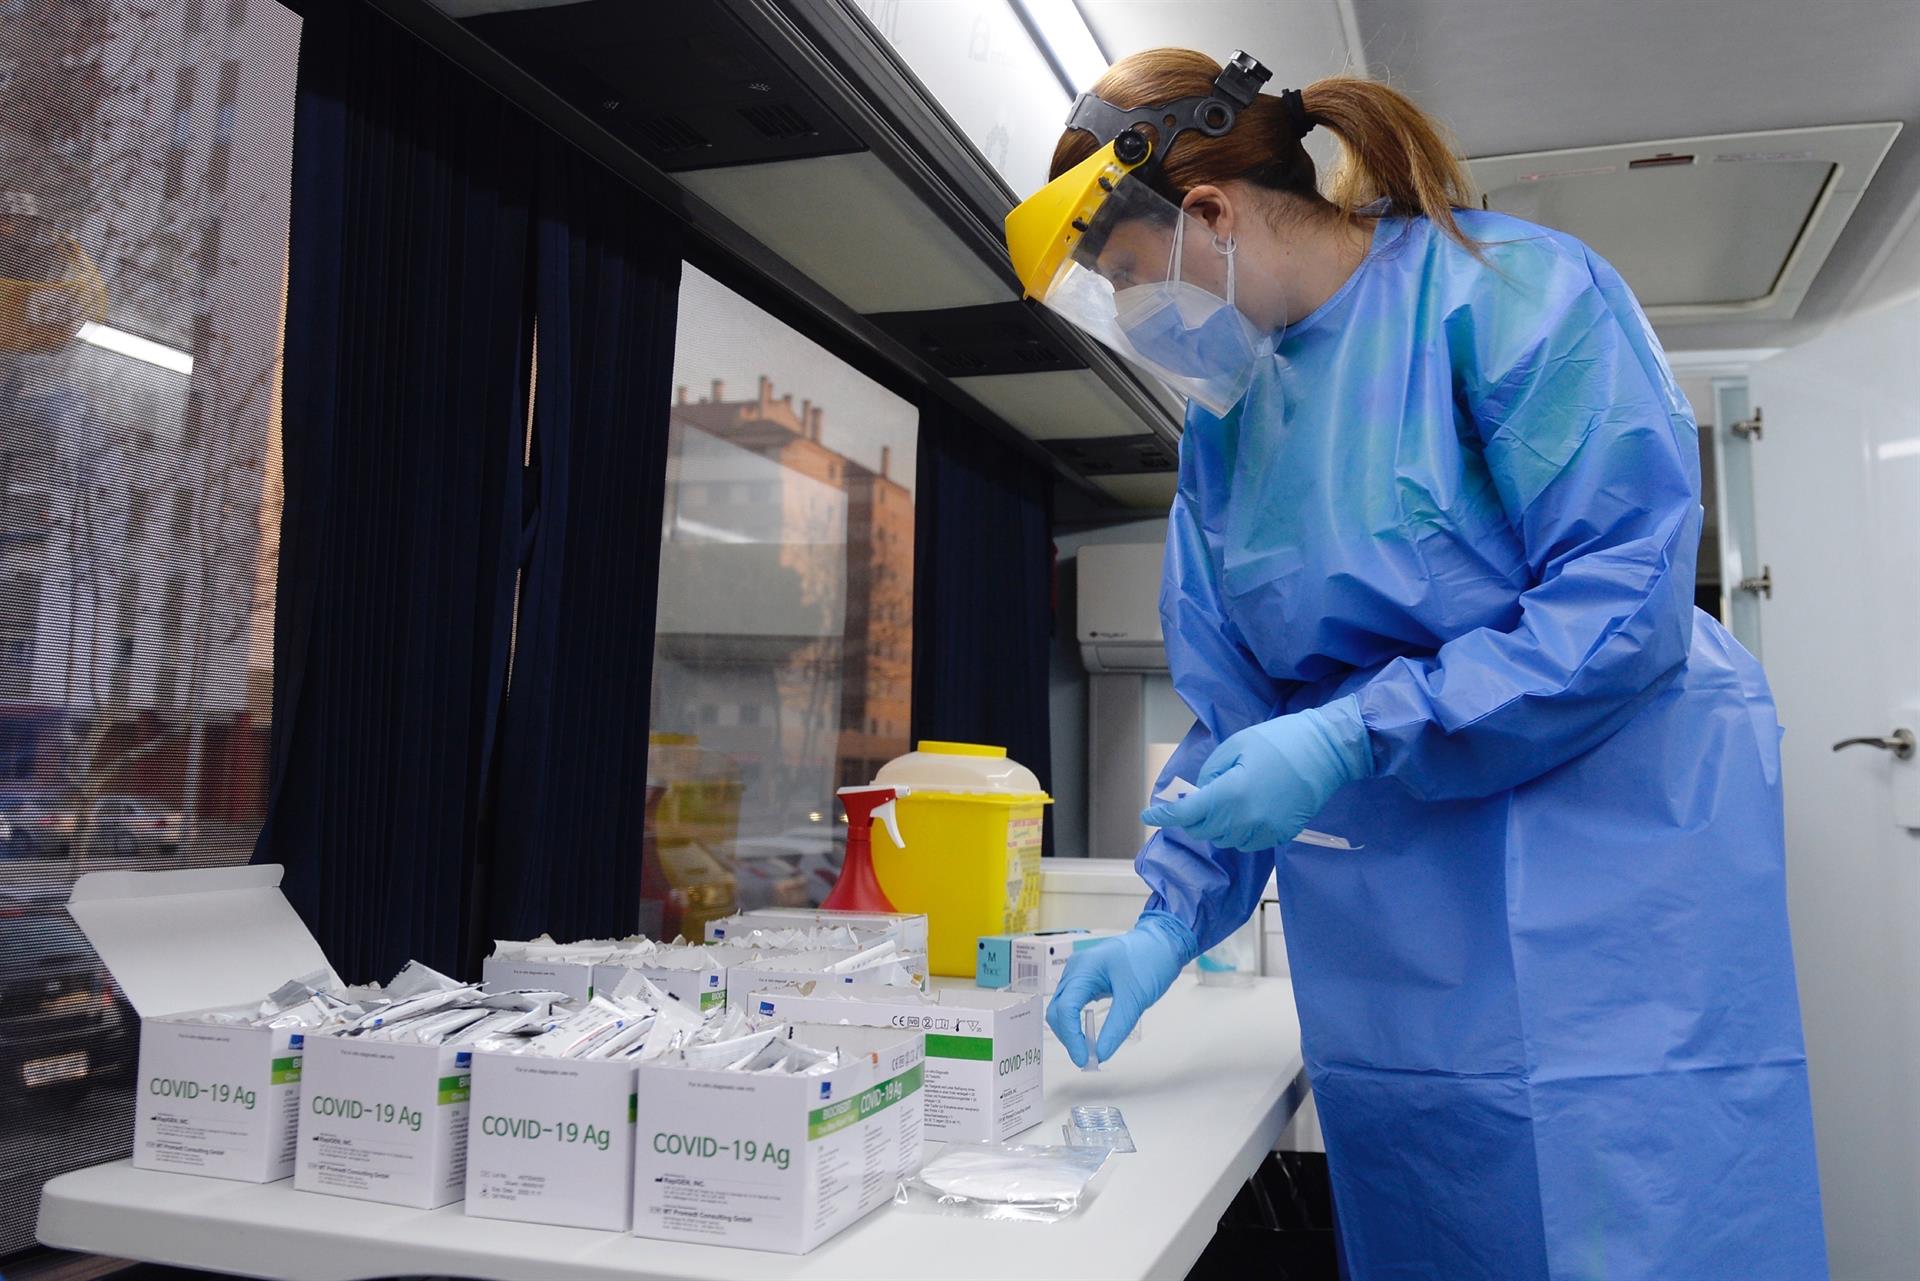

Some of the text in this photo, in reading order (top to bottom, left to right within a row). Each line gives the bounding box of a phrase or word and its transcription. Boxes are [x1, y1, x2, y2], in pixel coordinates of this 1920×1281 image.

[999, 1047, 1041, 1076] COVID-19 Ag
[150, 1077, 256, 1110] COVID-19 Ag
[860, 1082, 894, 1114] COVID-19
[893, 1080, 903, 1100] Ag
[312, 1095, 422, 1132] COVID-19 Ag
[482, 1115, 610, 1151] COVID-19 Ag
[653, 1132, 790, 1170] COVID-19 Ag
